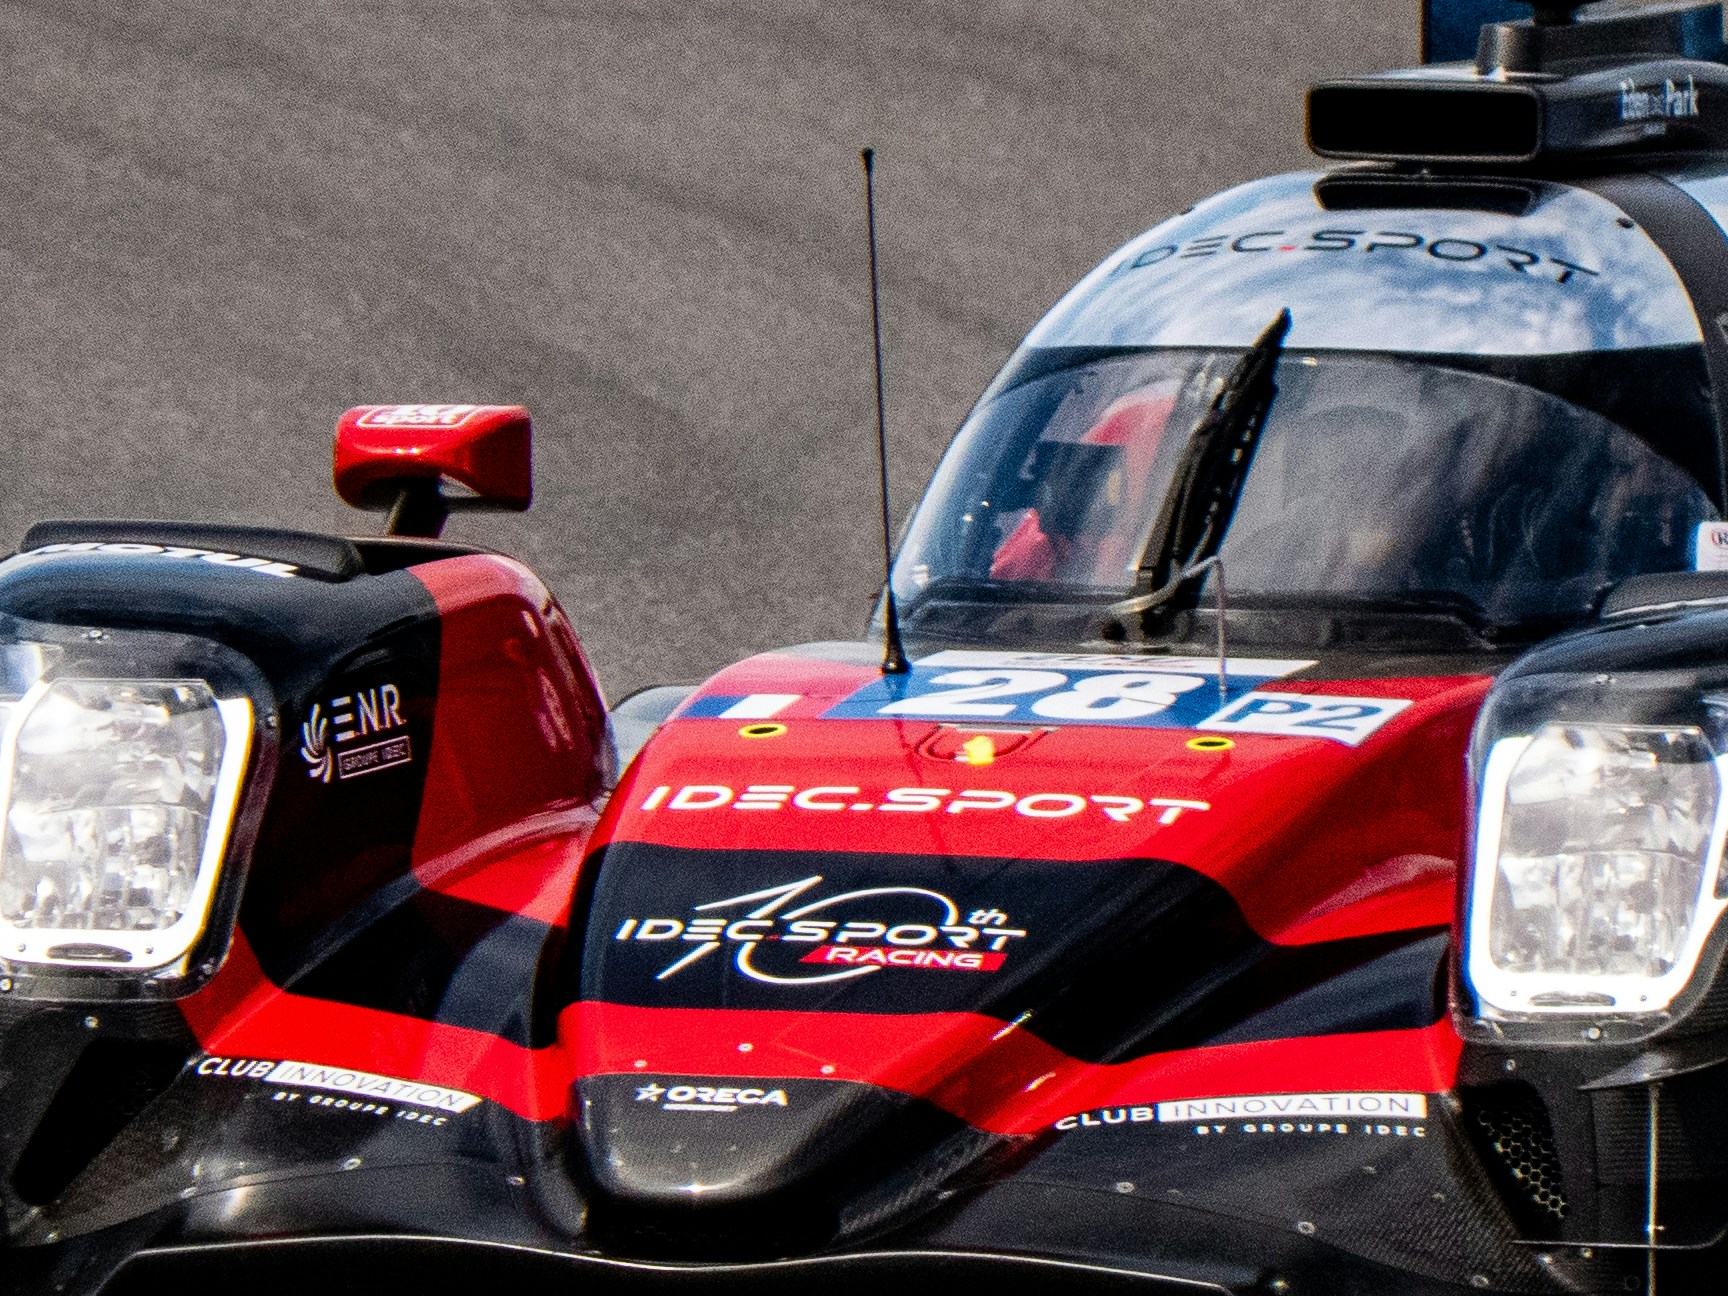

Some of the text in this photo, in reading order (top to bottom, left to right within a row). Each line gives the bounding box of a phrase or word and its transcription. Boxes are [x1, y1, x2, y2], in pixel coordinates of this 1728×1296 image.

[1128, 229, 1600, 285] DEC.SPORT
[332, 684, 403, 742] ENR
[876, 669, 1205, 720] 28
[1216, 697, 1386, 734] P2
[642, 785, 1212, 824] IDEC.SPORT
[824, 947, 985, 969] RACING
[196, 1057, 464, 1108] CLUB INNOVATION
[665, 1085, 788, 1107] ORECA
[272, 1091, 449, 1127] BY GROUPE IDEC
[1054, 1096, 1411, 1131] CLUB INNOVATION
[1194, 1122, 1426, 1138] BY GROUPE IDEC
